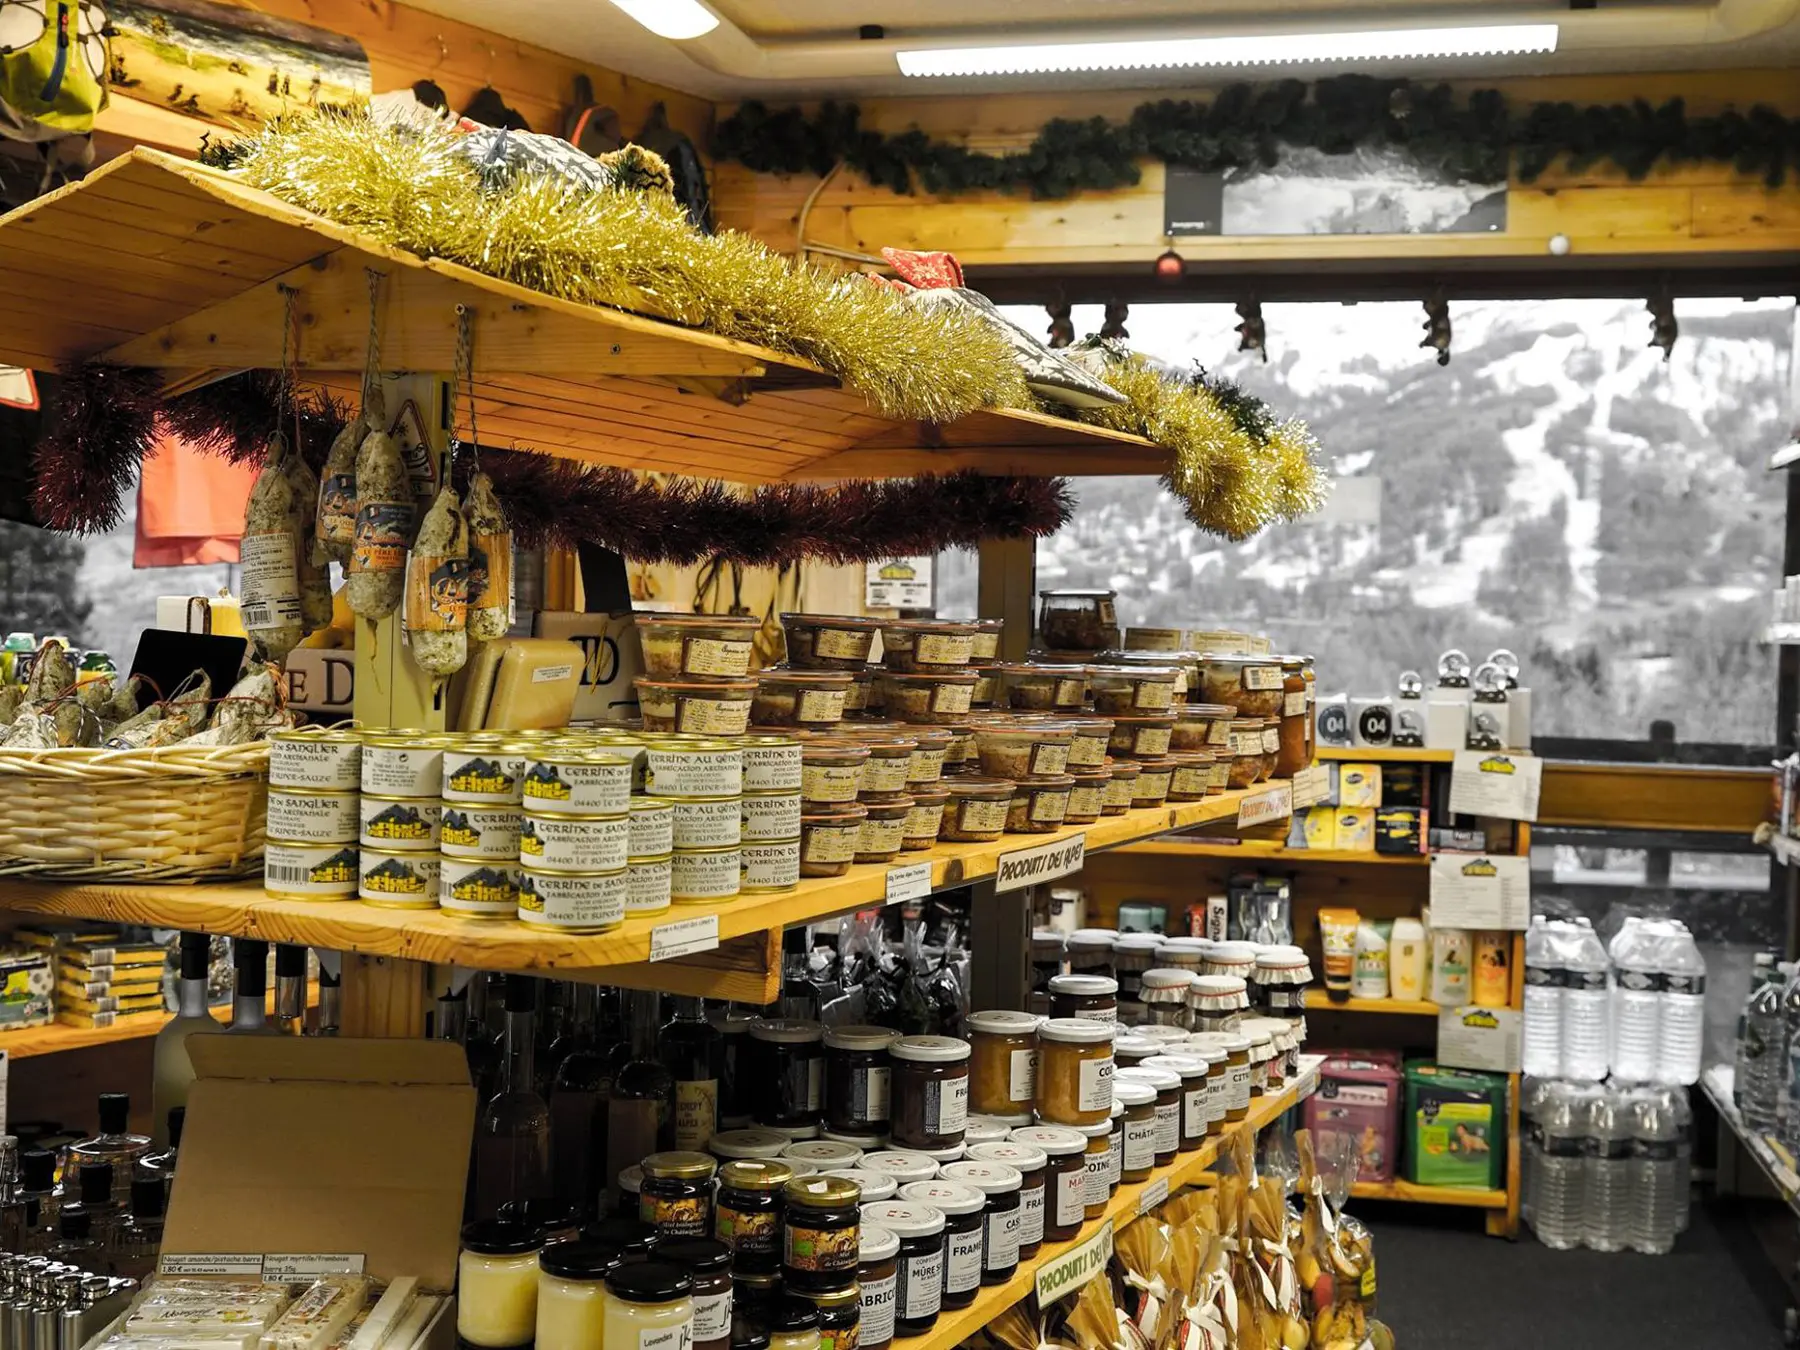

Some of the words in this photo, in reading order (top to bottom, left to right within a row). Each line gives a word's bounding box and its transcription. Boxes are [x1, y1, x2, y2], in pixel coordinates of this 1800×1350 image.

[1367, 718, 1386, 733] 04
[286, 742, 338, 754] SANGLIER
[651, 753, 691, 764] TERRINE
[694, 755, 712, 764] AU
[742, 750, 784, 759] TERRINE
[565, 767, 616, 776] TERRINE
[286, 797, 339, 809] SANGLIER
[742, 800, 786, 809] TERRINE
[697, 806, 714, 814] AU
[539, 822, 590, 834] TERRINE
[742, 848, 786, 857] TERRINE
[700, 856, 718, 864] AU
[999, 854, 1048, 882] PRODUITS
[539, 880, 590, 890] TERRINE
[164, 1256, 186, 1264] Nougat
[912, 1265, 935, 1278] MÛRE
[1040, 1252, 1088, 1297] PRODUITS
